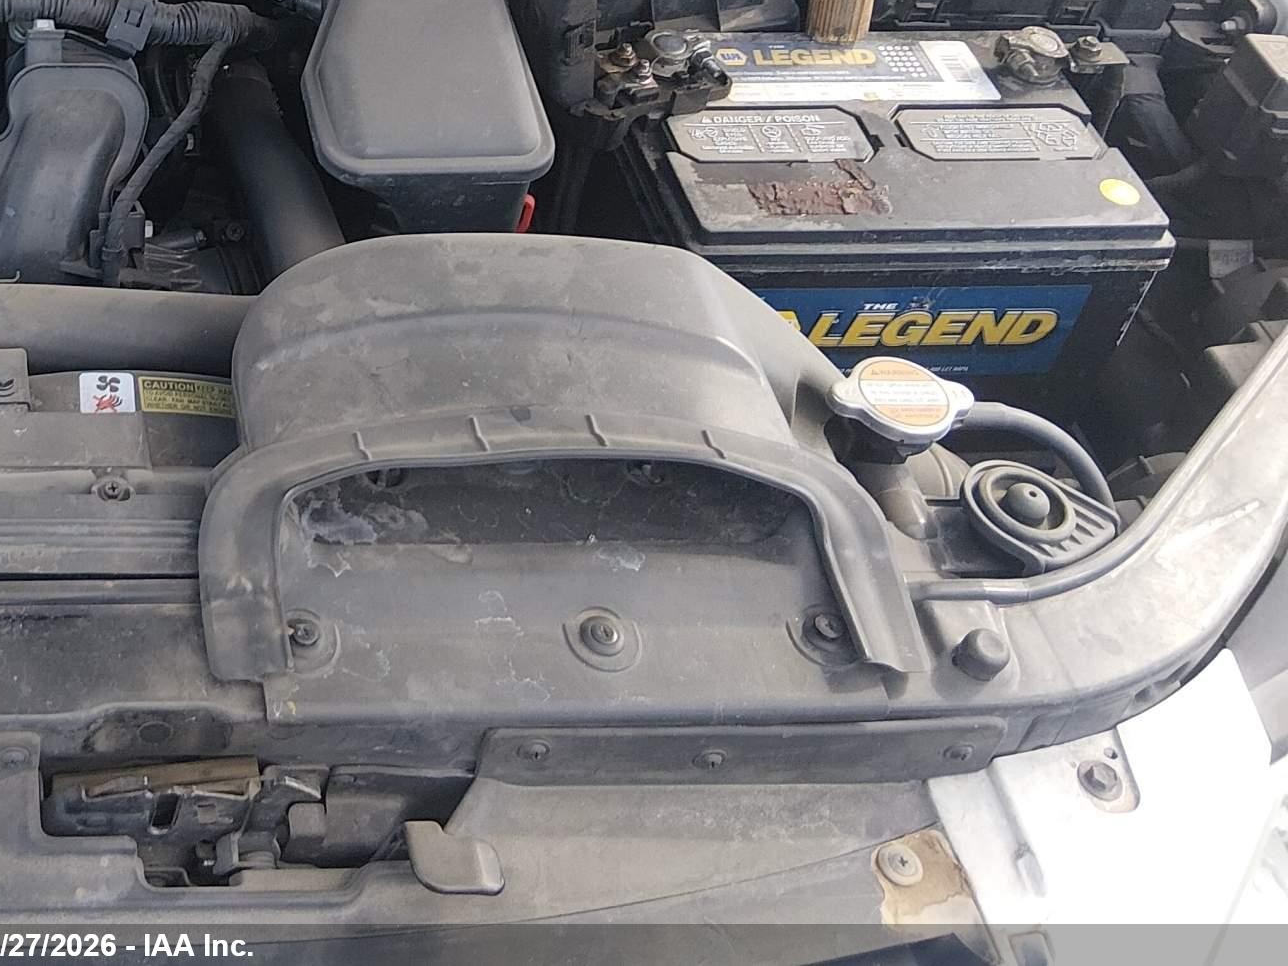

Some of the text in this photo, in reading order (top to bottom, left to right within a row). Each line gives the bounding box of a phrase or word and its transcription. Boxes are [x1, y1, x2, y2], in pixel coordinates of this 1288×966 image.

[752, 48, 877, 67] LEGEND
[713, 115, 763, 124] DANGER
[775, 115, 821, 123] POISON
[863, 302, 899, 311] THE
[807, 309, 1059, 348] LEGEND
[143, 380, 194, 392] CAUTION
